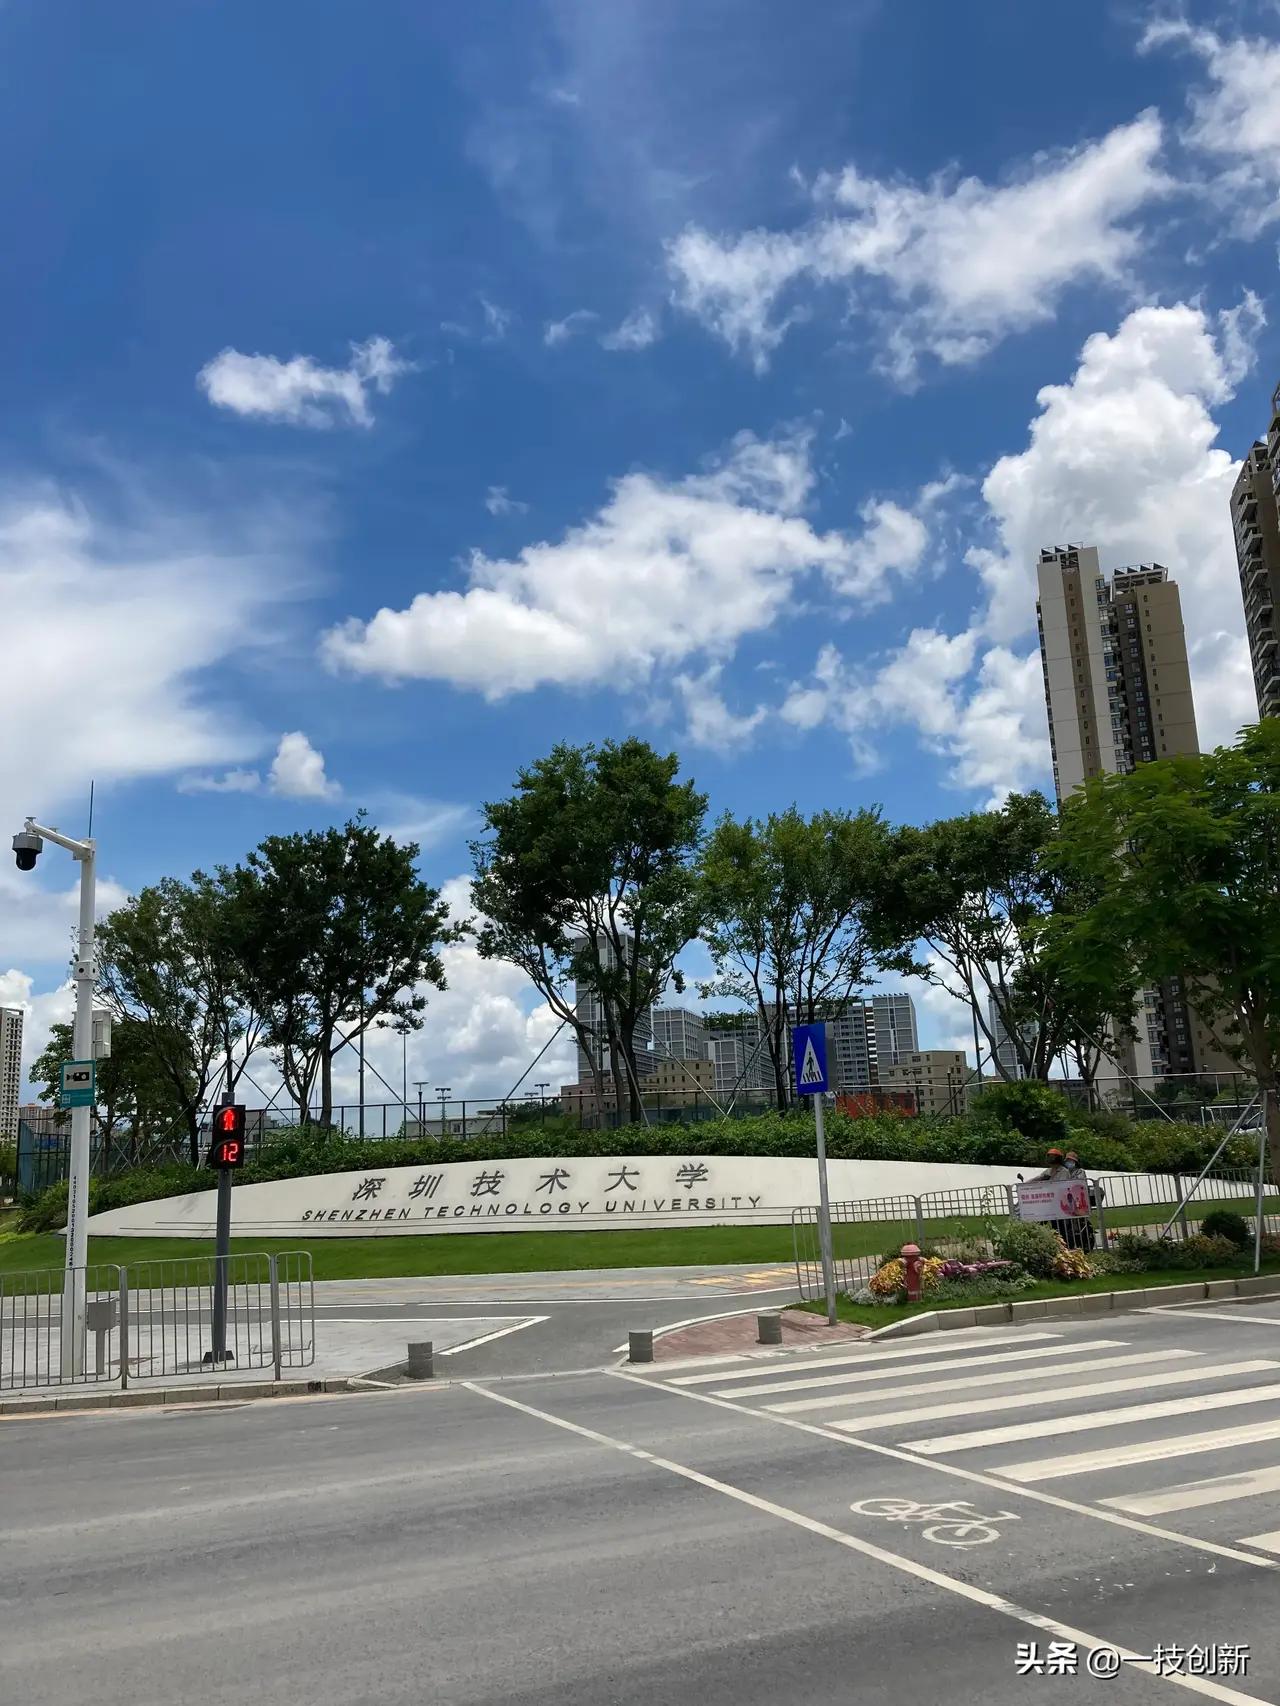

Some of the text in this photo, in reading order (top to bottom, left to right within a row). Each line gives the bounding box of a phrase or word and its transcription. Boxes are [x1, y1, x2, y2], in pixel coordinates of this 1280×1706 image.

[223, 1143, 238, 1162] 12
[352, 1162, 709, 1200] 深圳技术大学
[302, 1196, 761, 1221] SHENZHEN TECHNOLOGY UNIVERSITY
